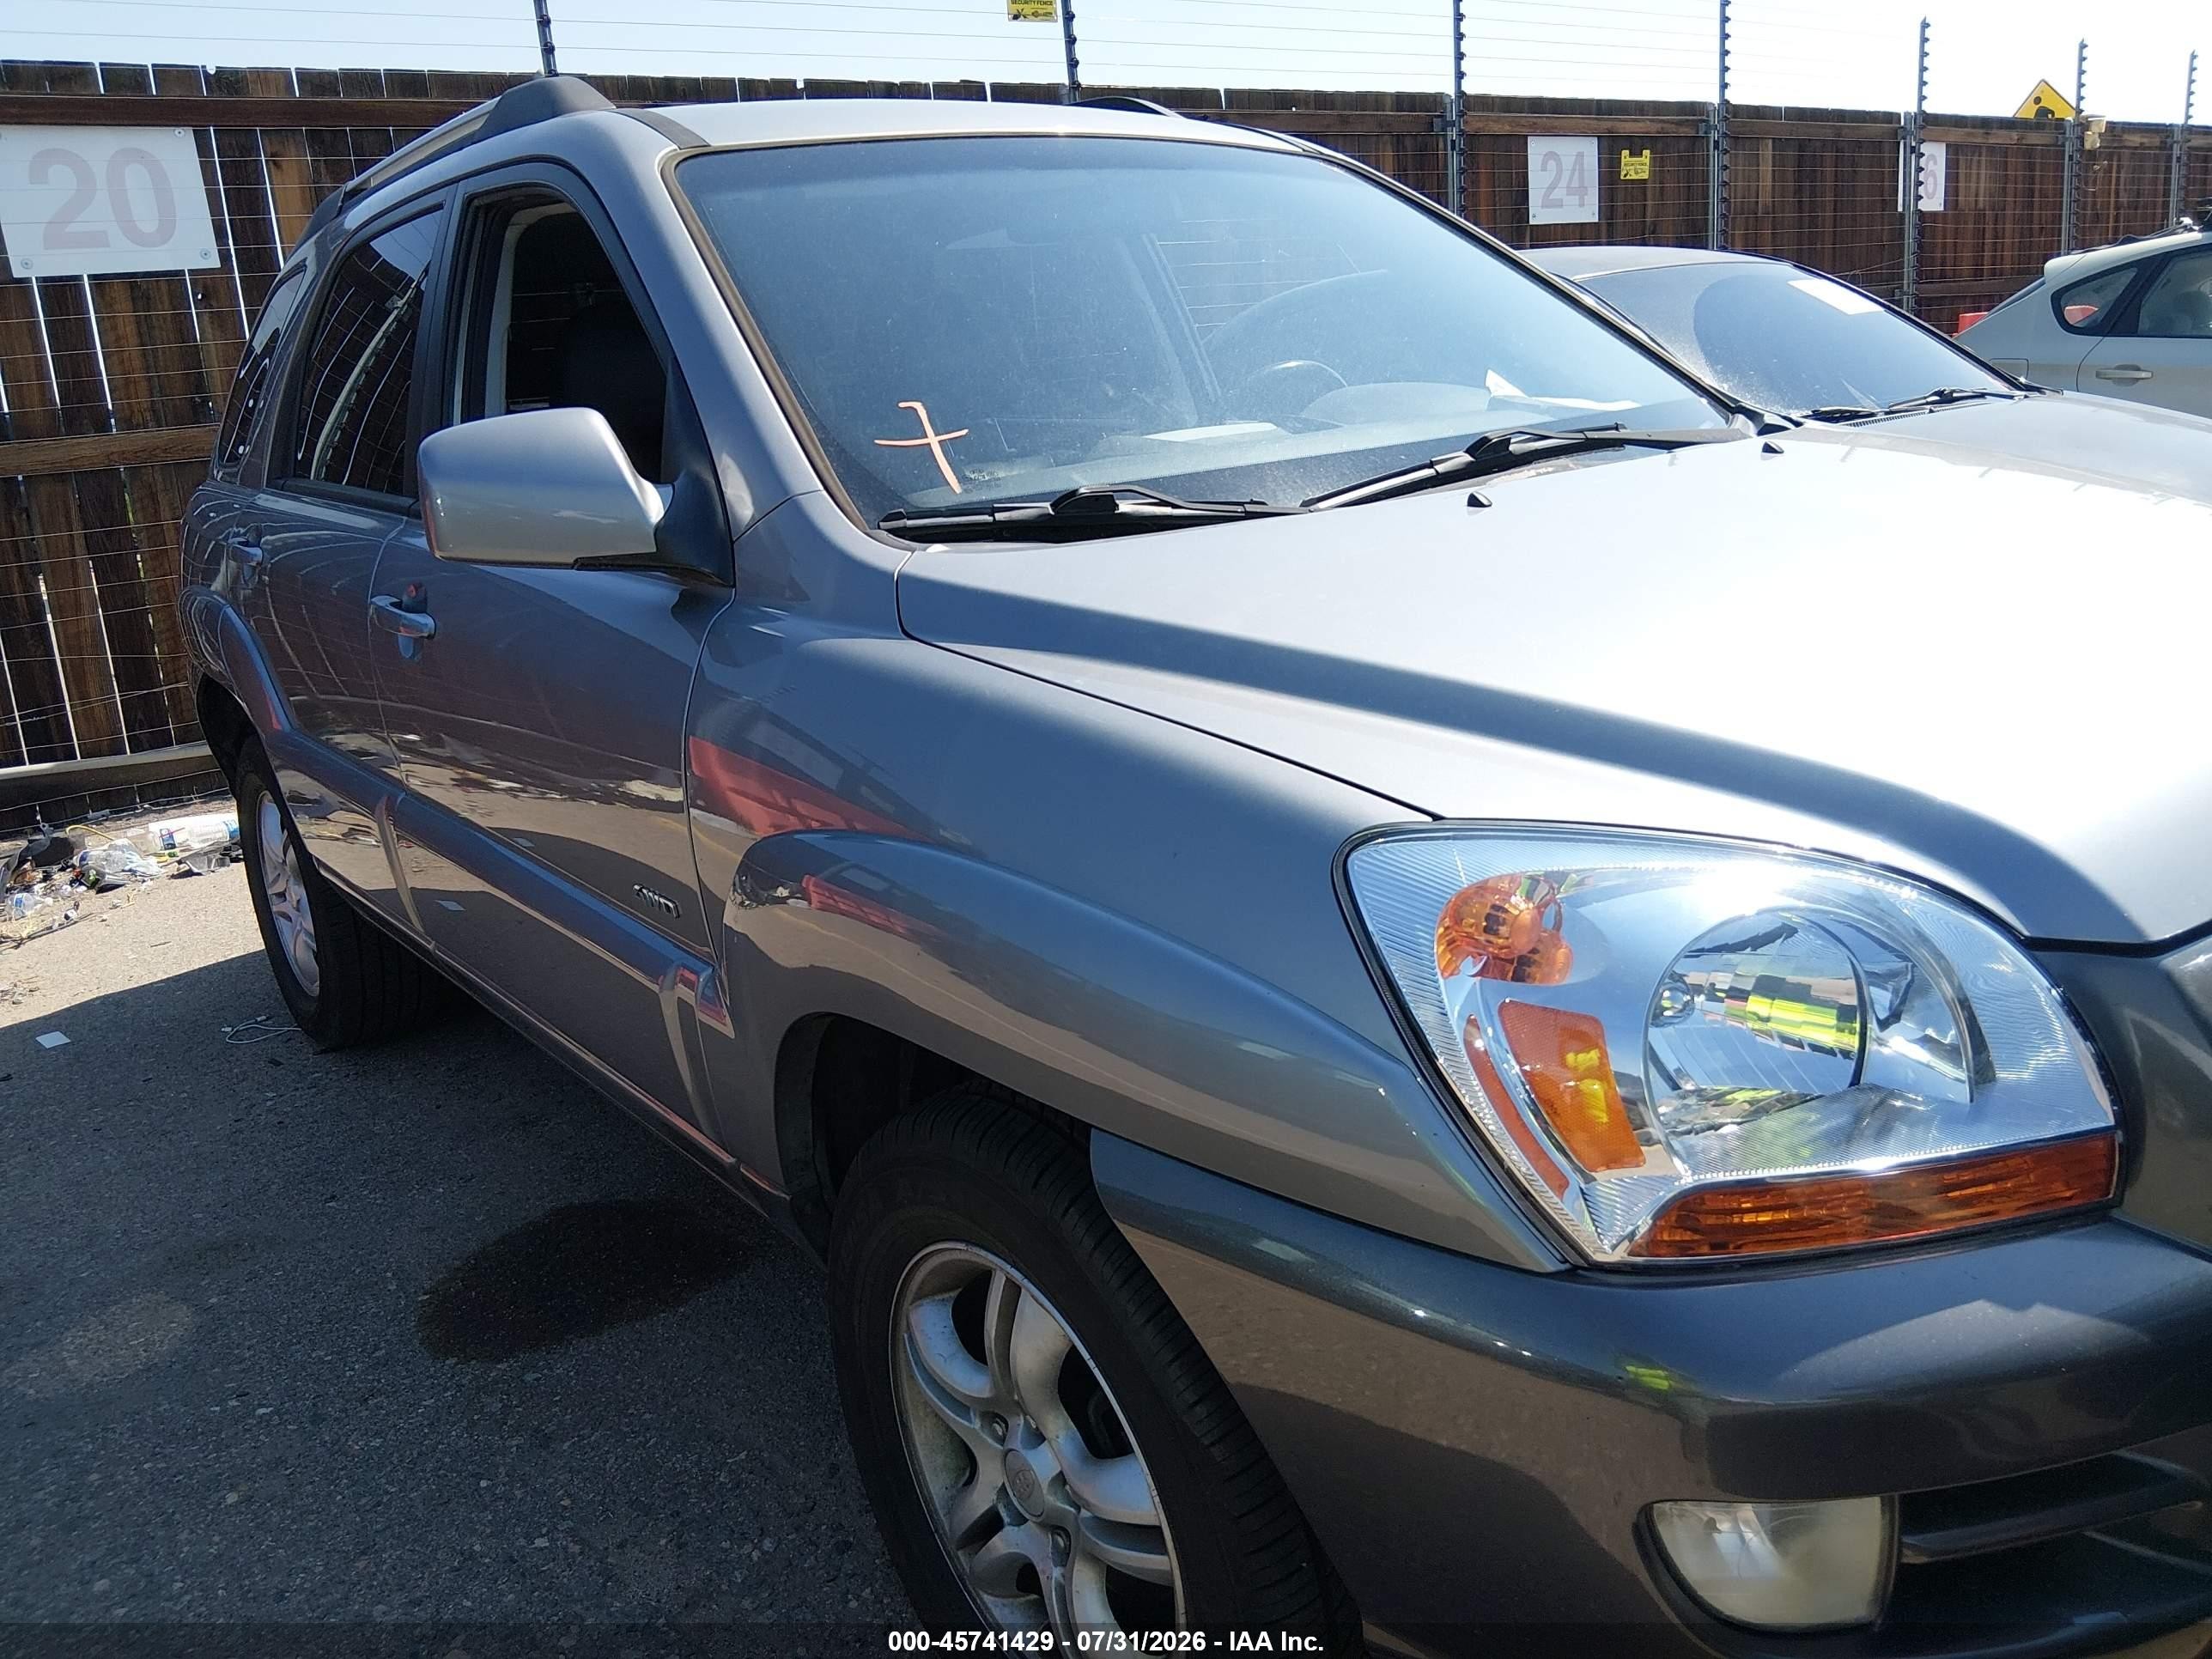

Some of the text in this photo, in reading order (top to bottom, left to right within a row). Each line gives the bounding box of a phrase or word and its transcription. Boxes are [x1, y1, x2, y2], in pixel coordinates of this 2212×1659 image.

[28, 147, 176, 250] 20
[1540, 150, 1589, 209] 24
[1923, 153, 1938, 200] 6
